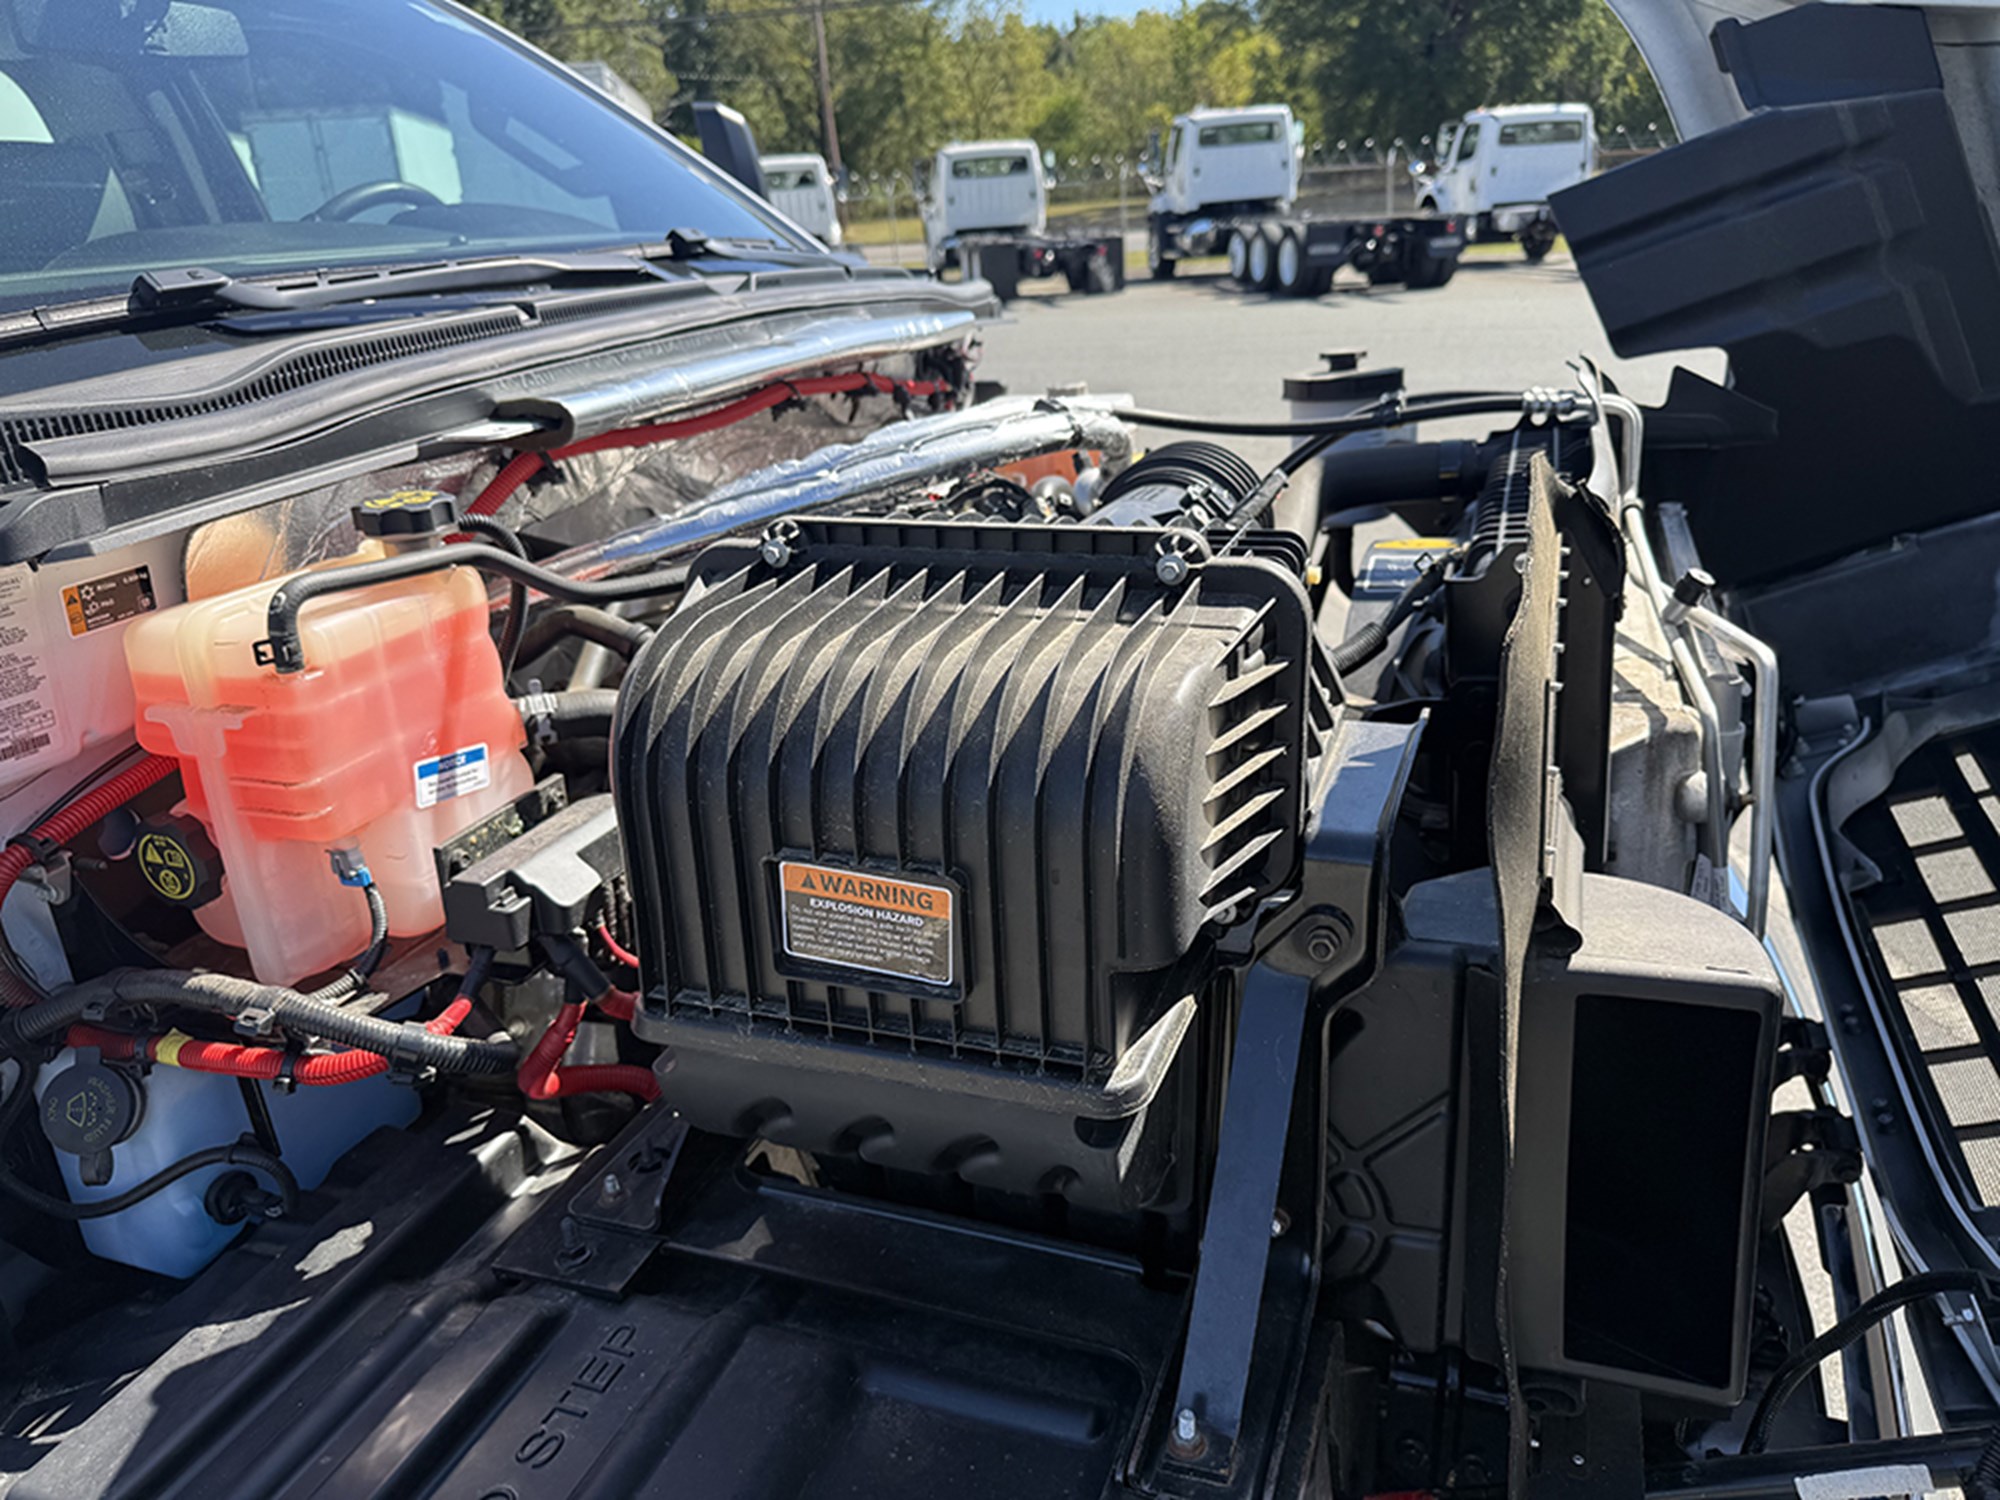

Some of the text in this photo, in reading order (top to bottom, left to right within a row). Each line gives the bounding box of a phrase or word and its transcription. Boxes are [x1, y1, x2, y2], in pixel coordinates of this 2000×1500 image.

[819, 874, 934, 911] WARNING
[809, 897, 874, 918] EXPLOSION
[876, 910, 924, 927] HAZARD
[515, 1325, 637, 1469] STEP
